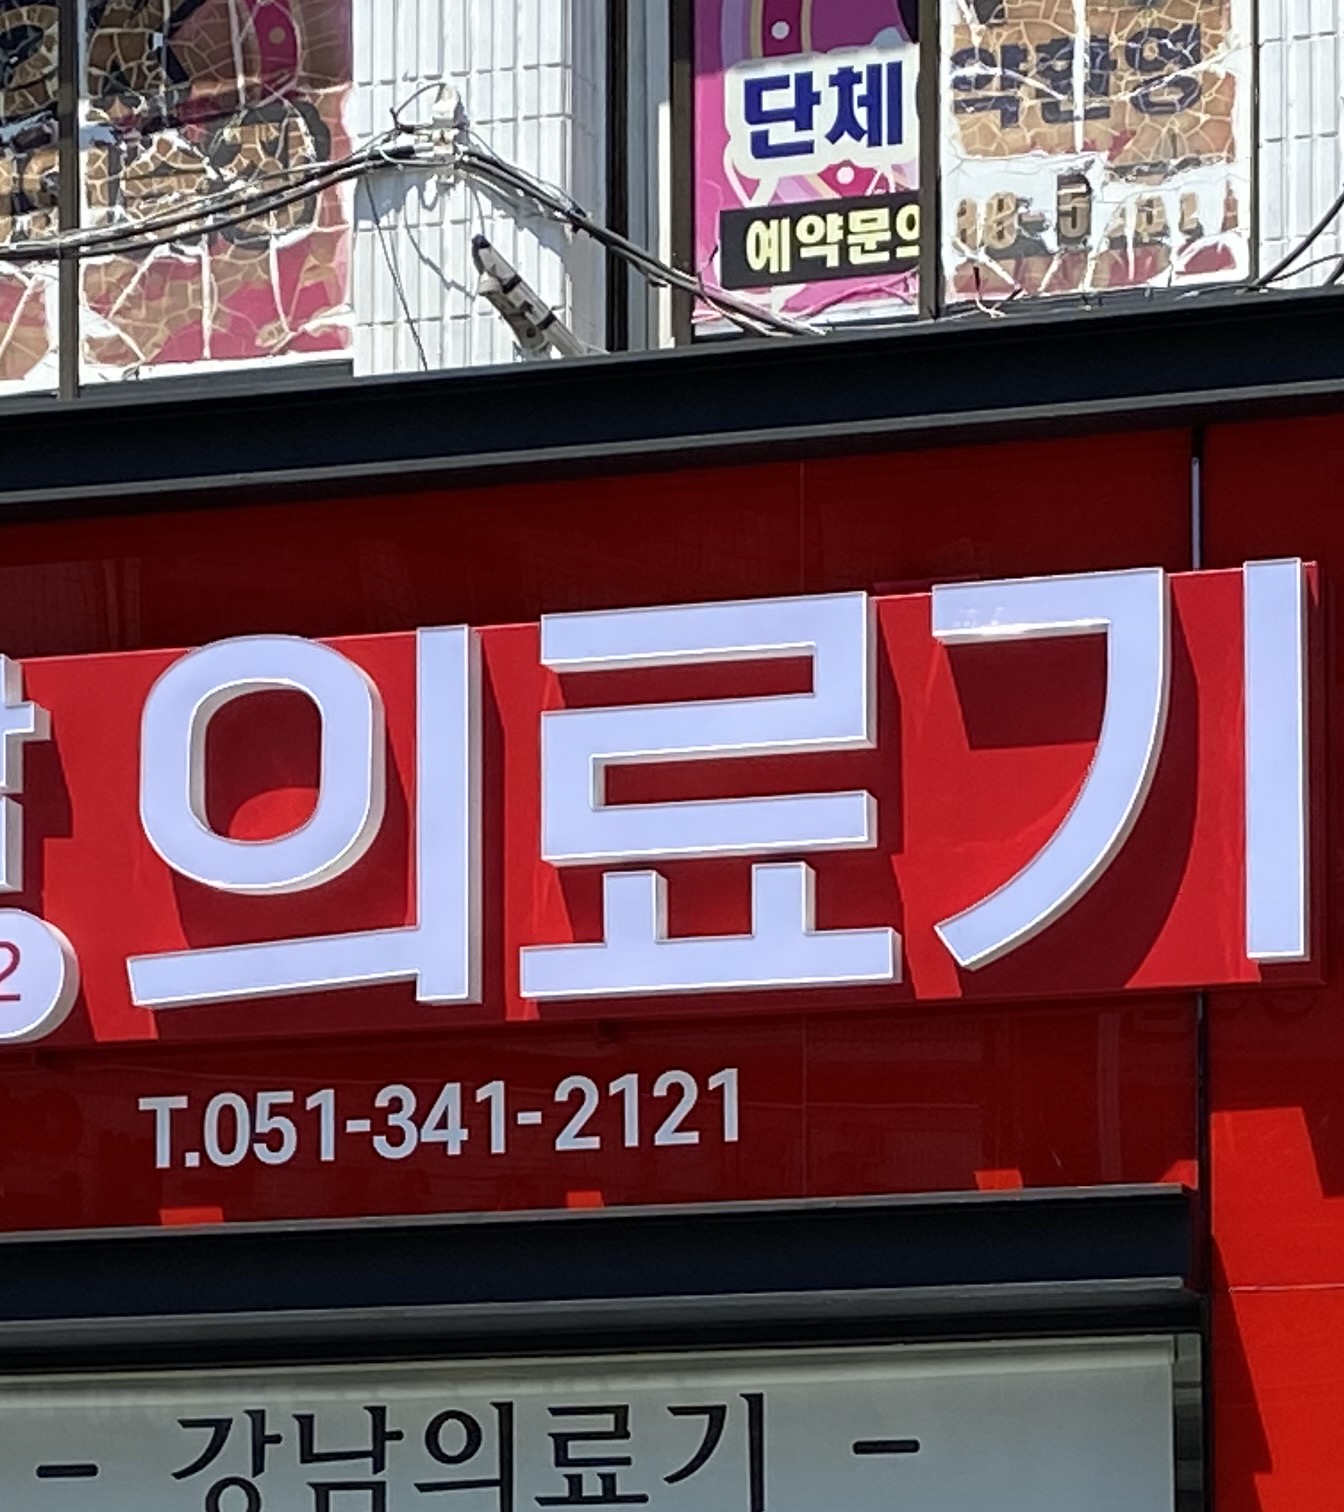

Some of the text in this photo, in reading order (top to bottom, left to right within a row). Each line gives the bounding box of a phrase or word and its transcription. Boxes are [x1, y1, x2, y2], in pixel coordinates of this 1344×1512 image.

[741, 59, 905, 162] 단체
[125, 558, 1312, 1008] 의료기
[137, 1067, 742, 1171] T.051-341-2121
